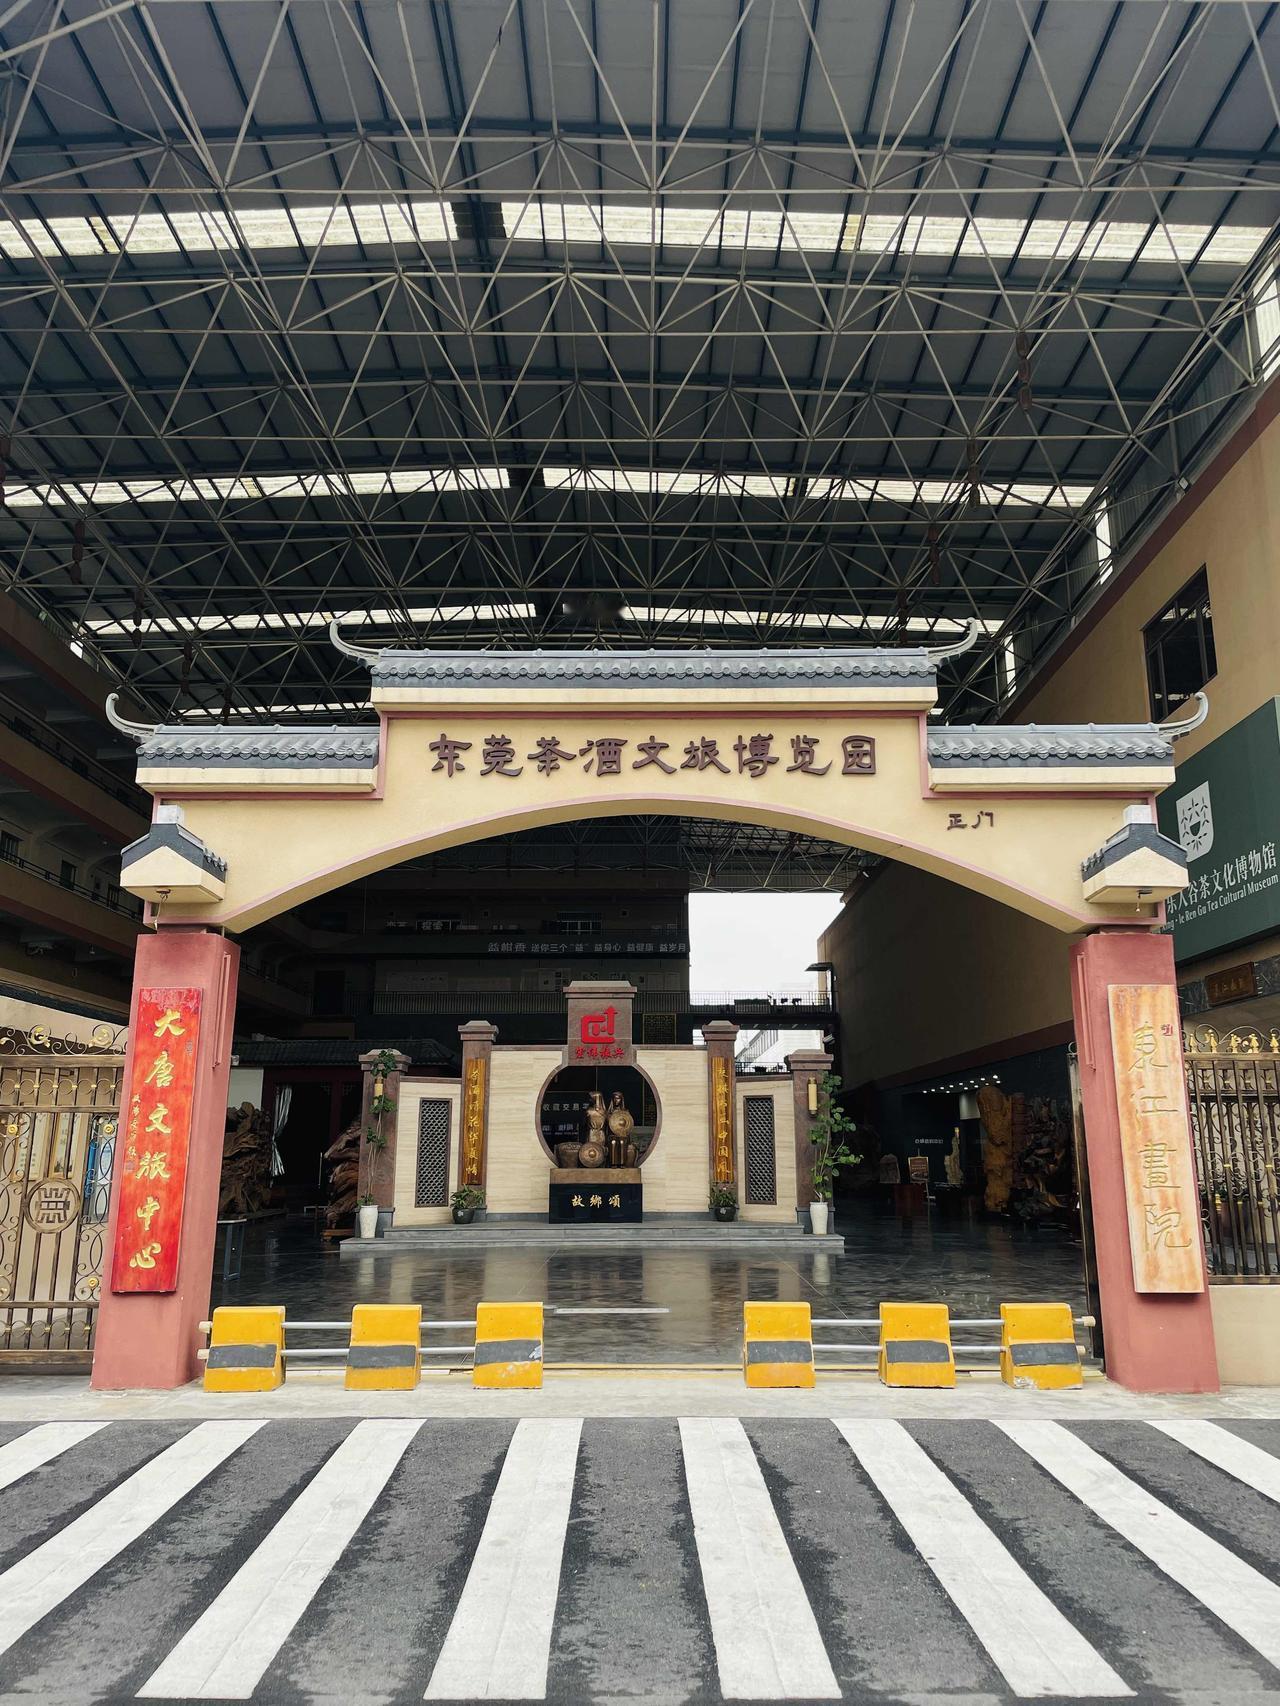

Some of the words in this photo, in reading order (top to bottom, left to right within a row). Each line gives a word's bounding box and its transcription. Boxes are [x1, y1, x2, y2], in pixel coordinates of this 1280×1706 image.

[429, 733, 877, 778] 东莞茶酒文旅博览园
[946, 810, 994, 831] 正门
[1185, 908, 1197, 922] Ren
[1197, 904, 1207, 917] Gu
[1206, 899, 1219, 913] Tea
[1218, 884, 1247, 908] Cultural
[1246, 873, 1279, 896] Museum
[129, 1007, 185, 1270] 大唐文旅中心
